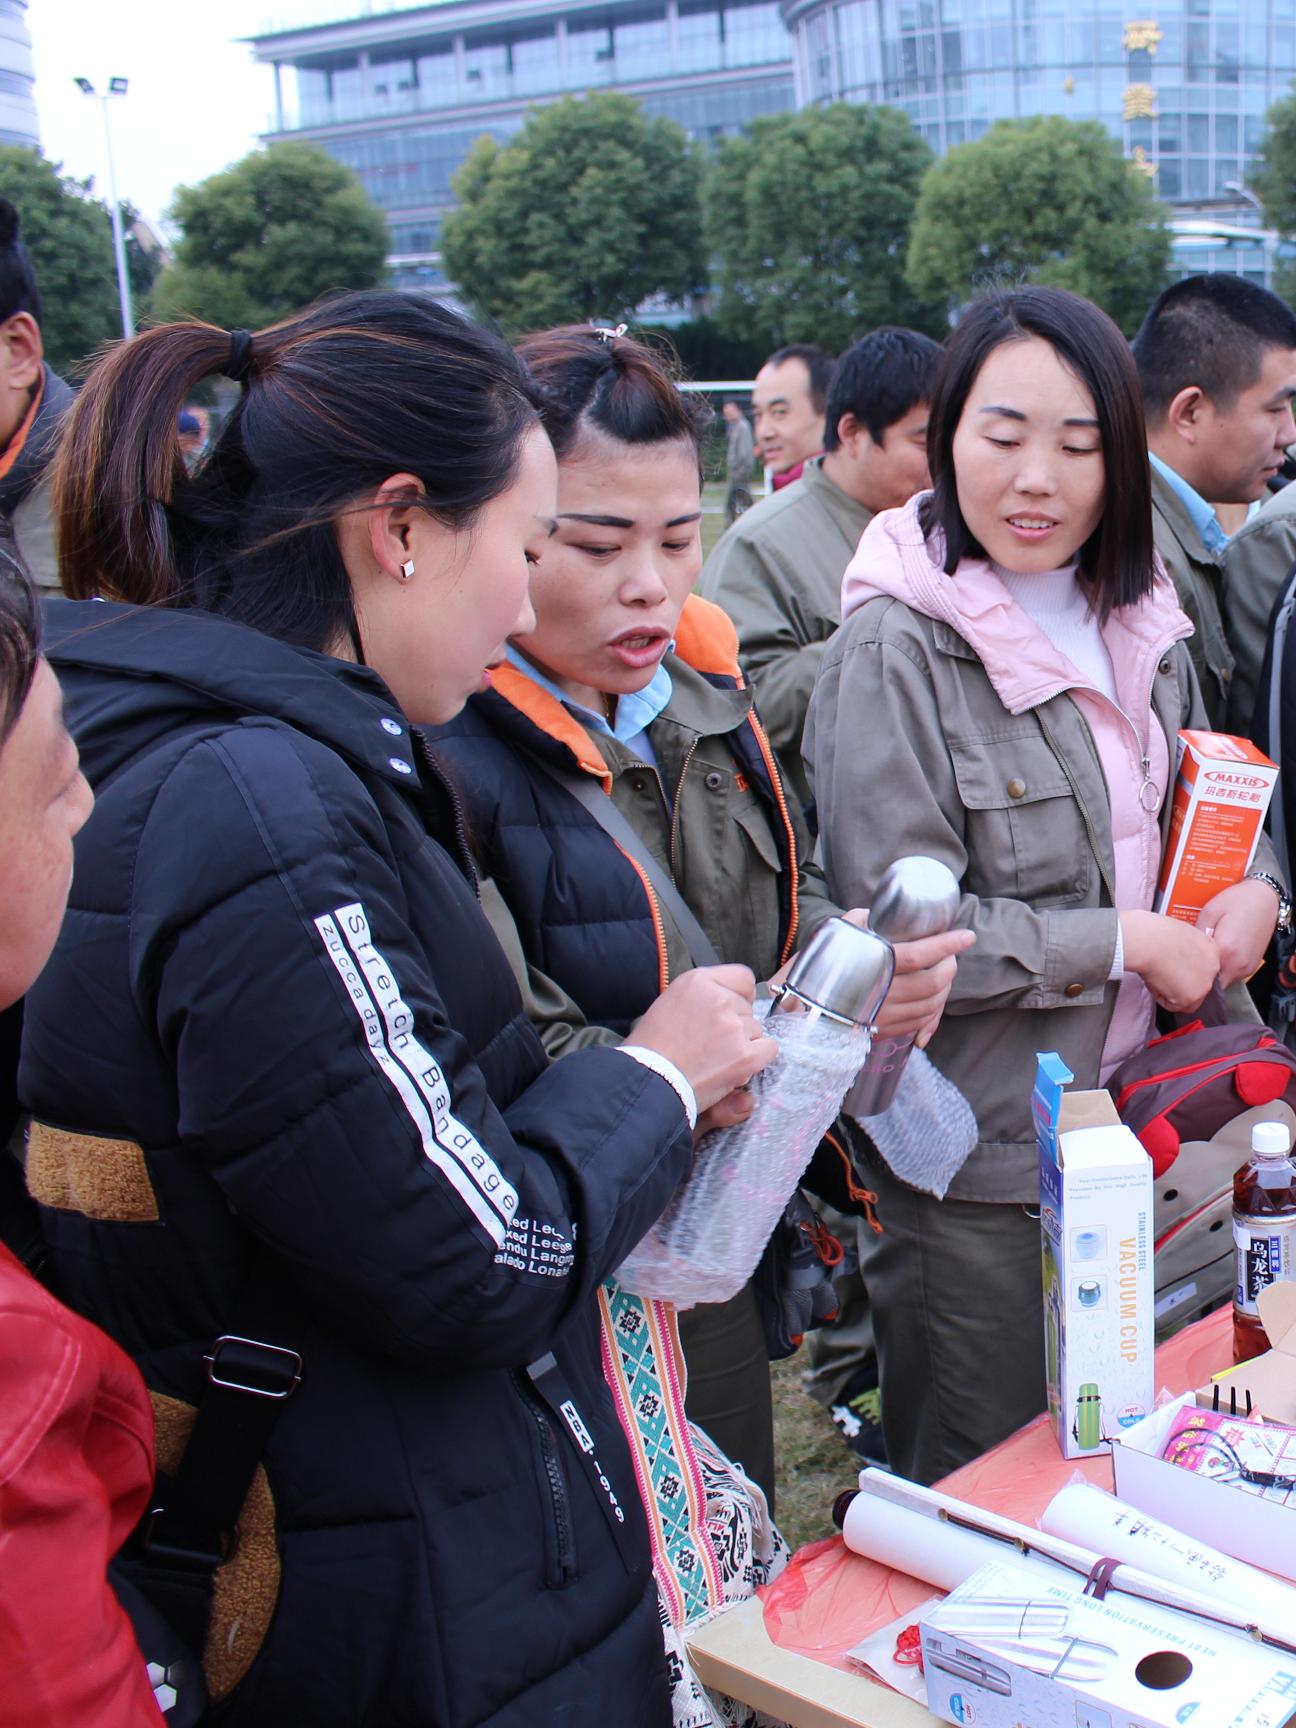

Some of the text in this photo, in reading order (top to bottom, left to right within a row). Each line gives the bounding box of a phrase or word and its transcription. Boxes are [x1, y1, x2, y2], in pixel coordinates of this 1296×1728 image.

[1214, 773, 1260, 787] MAXXIS
[348, 914, 516, 1212] Stretch Bandage
[1138, 1249, 1147, 1271] STEEL
[1119, 1237, 1138, 1363] VACUUM CUP
[1046, 1586, 1218, 1658] HEAT PRESERVATION LONG TIME
